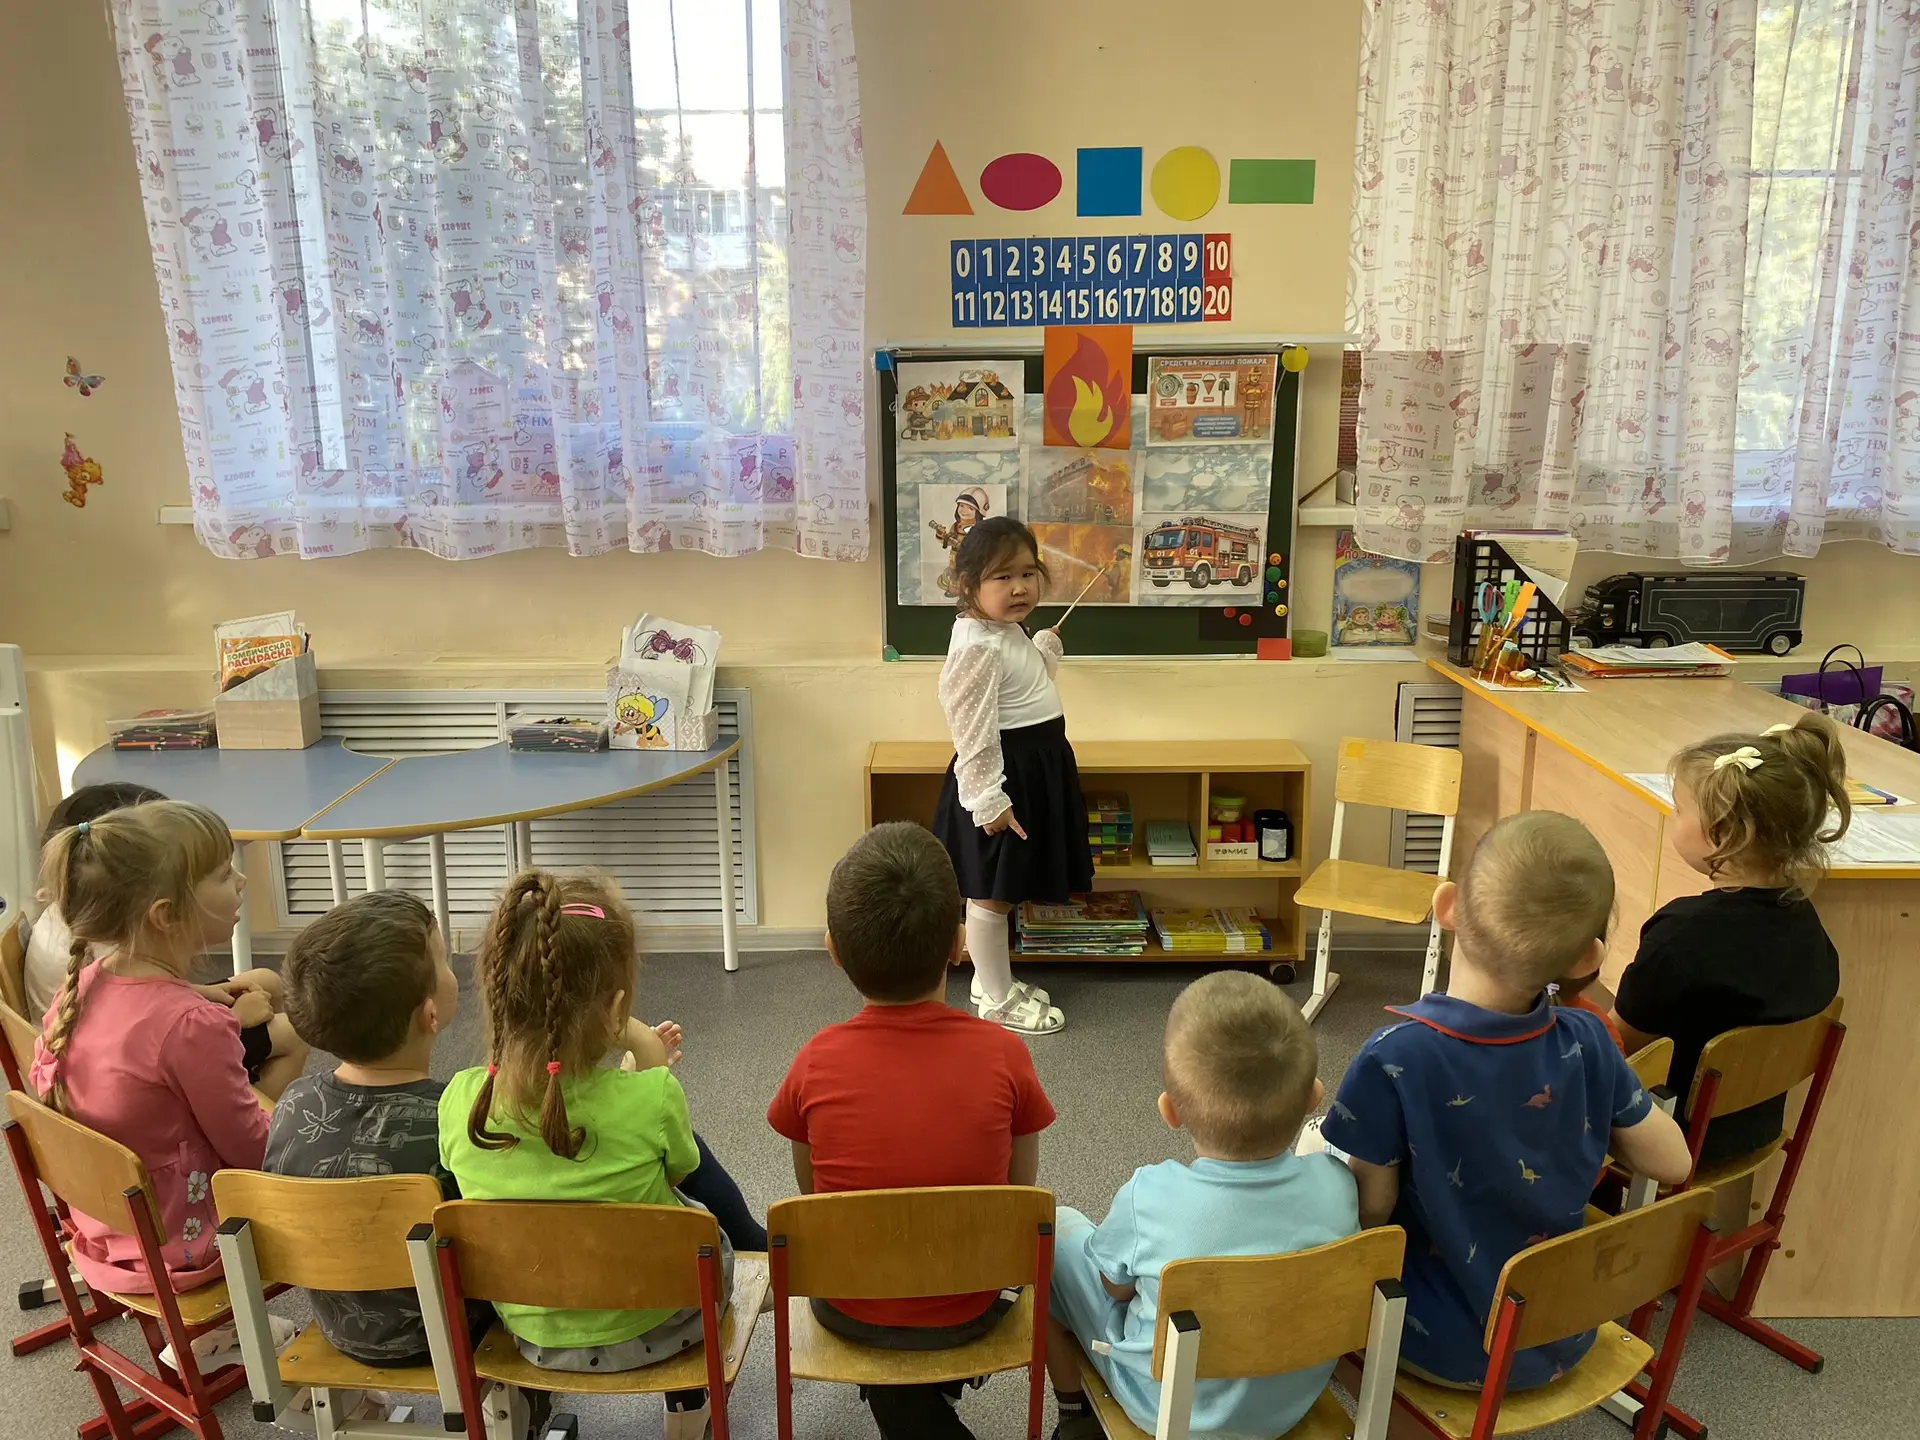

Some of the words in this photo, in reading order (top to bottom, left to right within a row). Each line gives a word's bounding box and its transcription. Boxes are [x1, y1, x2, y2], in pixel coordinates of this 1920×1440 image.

[221, 51, 232, 71] FOR
[217, 150, 240, 160] NEW
[554, 175, 577, 187] HM
[1629, 194, 1652, 206] HM
[408, 217, 417, 237] FOR
[340, 258, 360, 271] HM
[516, 259, 536, 270] HM
[955, 247, 971, 278] 0
[981, 247, 993, 276] 1
[1006, 246, 1020, 276] 2
[1032, 246, 1045, 275] 3
[1056, 245, 1071, 274] 4
[1082, 245, 1095, 274] 5
[1107, 243, 1122, 274] 6
[1133, 243, 1147, 273] 7
[1158, 242, 1172, 272] 8
[1183, 241, 1198, 272] 9
[1206, 240, 1228, 271] 10
[1394, 261, 1412, 270] NEW
[1877, 282, 1899, 293] HM
[954, 291, 975, 321] 11
[982, 291, 1005, 320] 12
[1010, 290, 1033, 320] 13
[1038, 289, 1062, 318] 14
[1066, 289, 1089, 318] 15
[1095, 288, 1118, 318] 16
[1123, 287, 1147, 317] 17
[1150, 286, 1174, 317] 18
[1178, 286, 1202, 316] 19
[1204, 285, 1230, 315] 20
[397, 311, 419, 320] NEW
[1866, 325, 1874, 344] FOR
[841, 341, 860, 352] HM
[1789, 344, 1797, 363] FOR
[1160, 359, 1197, 367] СРЕДСТВА
[1626, 359, 1646, 370] HM
[357, 416, 377, 428] HM
[532, 416, 552, 428] HM
[1383, 422, 1401, 432] NEW
[1843, 421, 1867, 429] NEW
[1405, 422, 1427, 436] NO.
[1402, 446, 1424, 460] HM
[1529, 446, 1542, 454] NO
[1381, 484, 1391, 503] FOR
[840, 499, 859, 510] HM
[1592, 515, 1614, 525] HM
[1906, 529, 1919, 538] NO
[1189, 548, 1198, 556] 01
[1344, 550, 1359, 559] ПО
[228, 648, 293, 669] РАСКРАСКА
